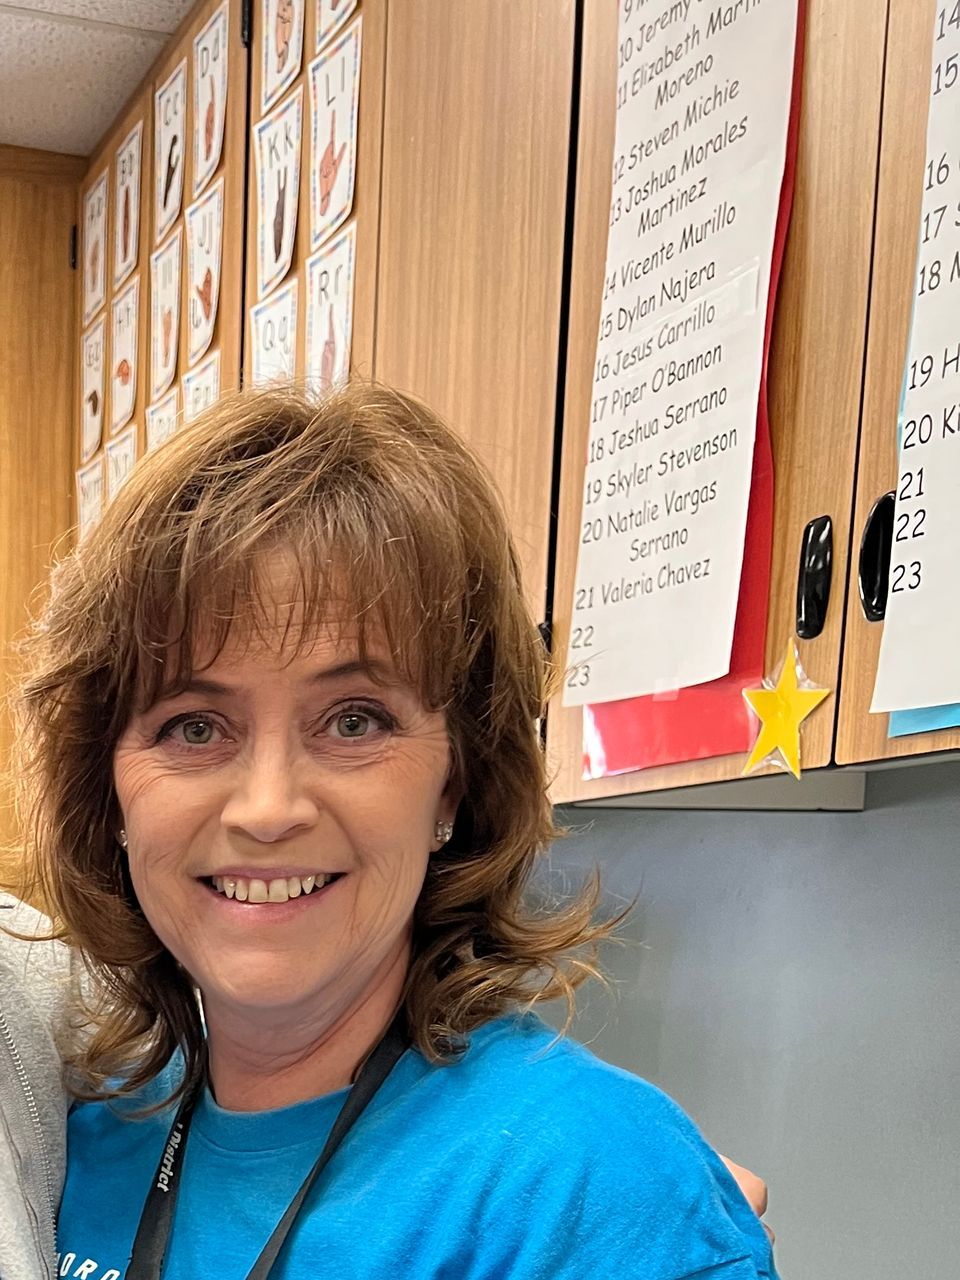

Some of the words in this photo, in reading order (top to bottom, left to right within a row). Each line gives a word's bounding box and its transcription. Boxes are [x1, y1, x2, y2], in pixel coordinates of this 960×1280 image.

[619, 36, 633, 69] 10
[635, 0, 691, 51] Jeremy
[617, 80, 627, 110] 11
[632, 24, 700, 97] Elizabeth
[655, 54, 714, 110] Moreno
[933, 53, 959, 96] 15
[613, 155, 625, 185] 12
[628, 119, 679, 171] Steven
[683, 79, 740, 131] Michie
[610, 198, 622, 227] 13
[625, 164, 677, 214] Joshua
[681, 115, 748, 177] Morales
[925, 152, 950, 191] 16
[637, 177, 708, 238] Martinez
[922, 205, 948, 244] 17
[604, 271, 617, 301] 14
[621, 241, 674, 288] Vicente
[679, 201, 736, 254] Murillo
[600, 313, 612, 341] 15
[617, 294, 655, 333] Dylan
[660, 261, 716, 307] Najera
[918, 260, 941, 297] 18
[595, 357, 609, 383] 16
[612, 337, 654, 376] Jesus
[657, 300, 716, 350] Carrillo
[592, 396, 608, 424] 17
[611, 381, 647, 416] Piper
[652, 344, 722, 393] O'Bannon
[909, 355, 934, 391] 19
[590, 437, 604, 464] 18
[609, 417, 659, 455] Jeshua
[664, 387, 727, 430] Serrano
[903, 414, 933, 450] 20
[586, 479, 602, 505] 19
[606, 464, 653, 498] Skyler
[658, 428, 738, 477] Stevenson
[899, 467, 924, 501] 21
[582, 518, 604, 544] 20
[607, 500, 659, 538] Natalie
[664, 481, 717, 517] Vargas
[895, 509, 926, 543] 22
[629, 528, 689, 562] Serrano
[575, 587, 594, 611] 21
[601, 572, 653, 606] Valeria
[657, 558, 711, 590] Chavez
[891, 560, 922, 593] 23
[571, 625, 594, 649] 22
[567, 665, 590, 688] 23
